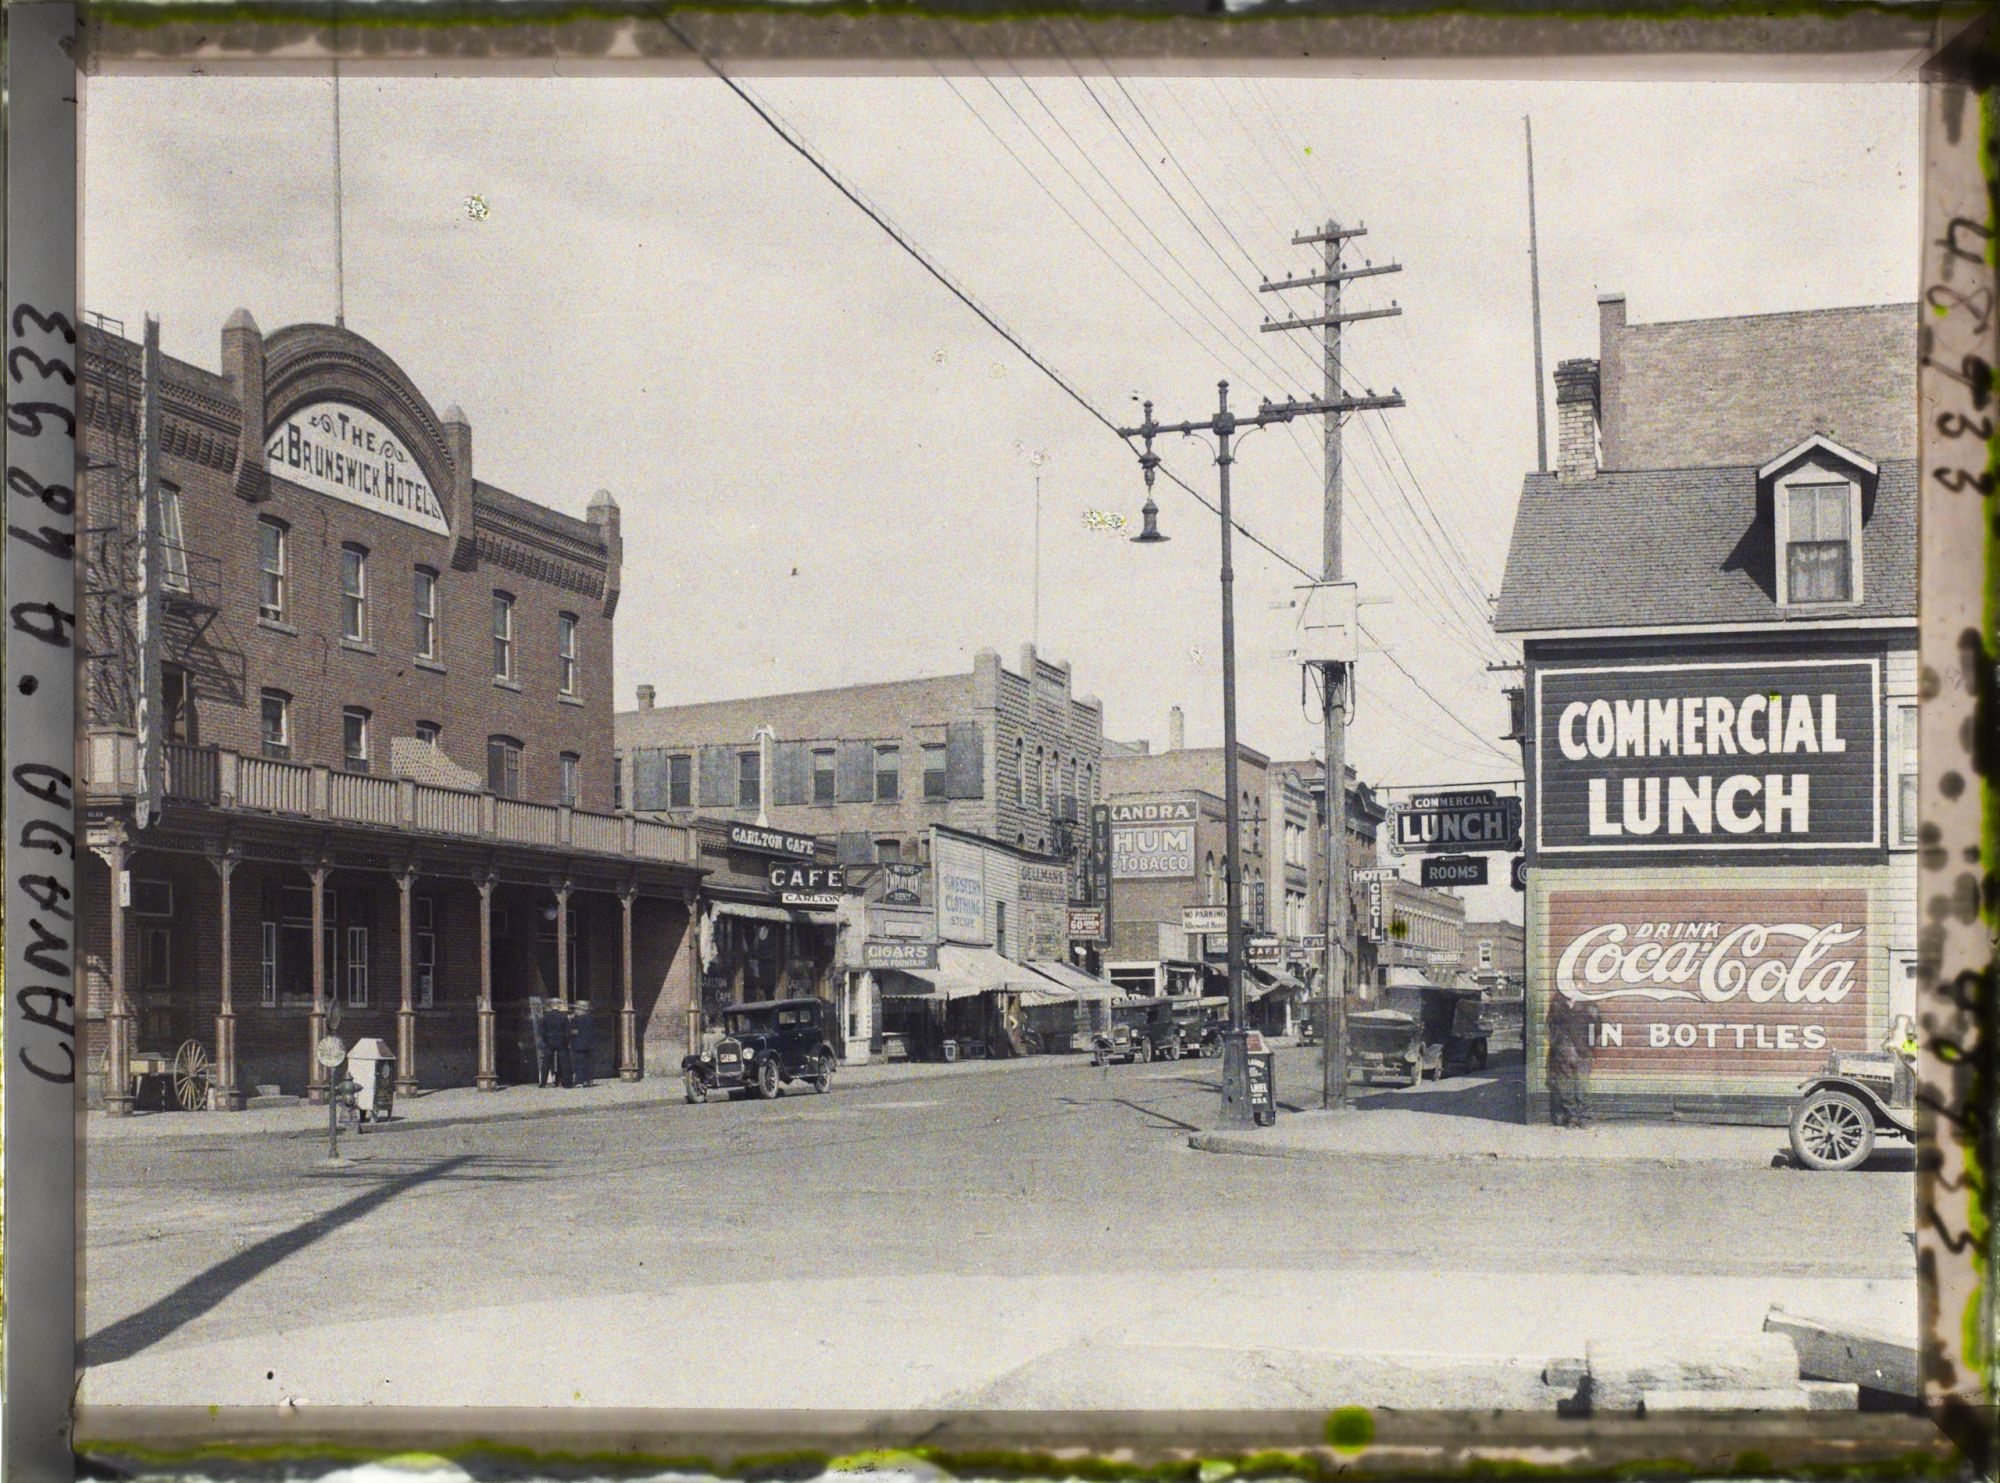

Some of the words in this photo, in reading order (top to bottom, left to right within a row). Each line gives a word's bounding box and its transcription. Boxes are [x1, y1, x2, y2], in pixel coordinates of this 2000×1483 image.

[337, 412, 376, 453] THE
[287, 422, 381, 499] BRUNSWICK
[385, 461, 431, 516] HOTEL
[1558, 693, 1847, 761] COMMERCIAL
[1415, 795, 1491, 808] COMMERCIAL
[1589, 774, 1810, 836] LUNCH
[1402, 811, 1504, 843] LUNCH
[732, 827, 784, 850] CARLTON
[786, 838, 815, 855] CAFE
[1113, 831, 1188, 853] HUM
[1353, 869, 1398, 882] HOTEL
[1429, 866, 1479, 881] ROOMS
[785, 893, 841, 903] CARLTON
[1184, 910, 1193, 919] NO
[1195, 910, 1226, 919] PARKING
[1256, 885, 1264, 932] HOTEL
[1369, 883, 1382, 940] CECIL
[12, 763, 76, 1084] CANADA
[951, 915, 975, 928] STORE
[1070, 920, 1083, 930] 60
[1634, 921, 1723, 940] DRINK
[868, 945, 929, 959] CIGARS
[1249, 947, 1279, 955] CAFE
[869, 959, 890, 968] SODA
[891, 959, 928, 968] FOUNTAIN
[1589, 1022, 1623, 1047] IN
[1649, 1023, 1827, 1050] BOTTLES
